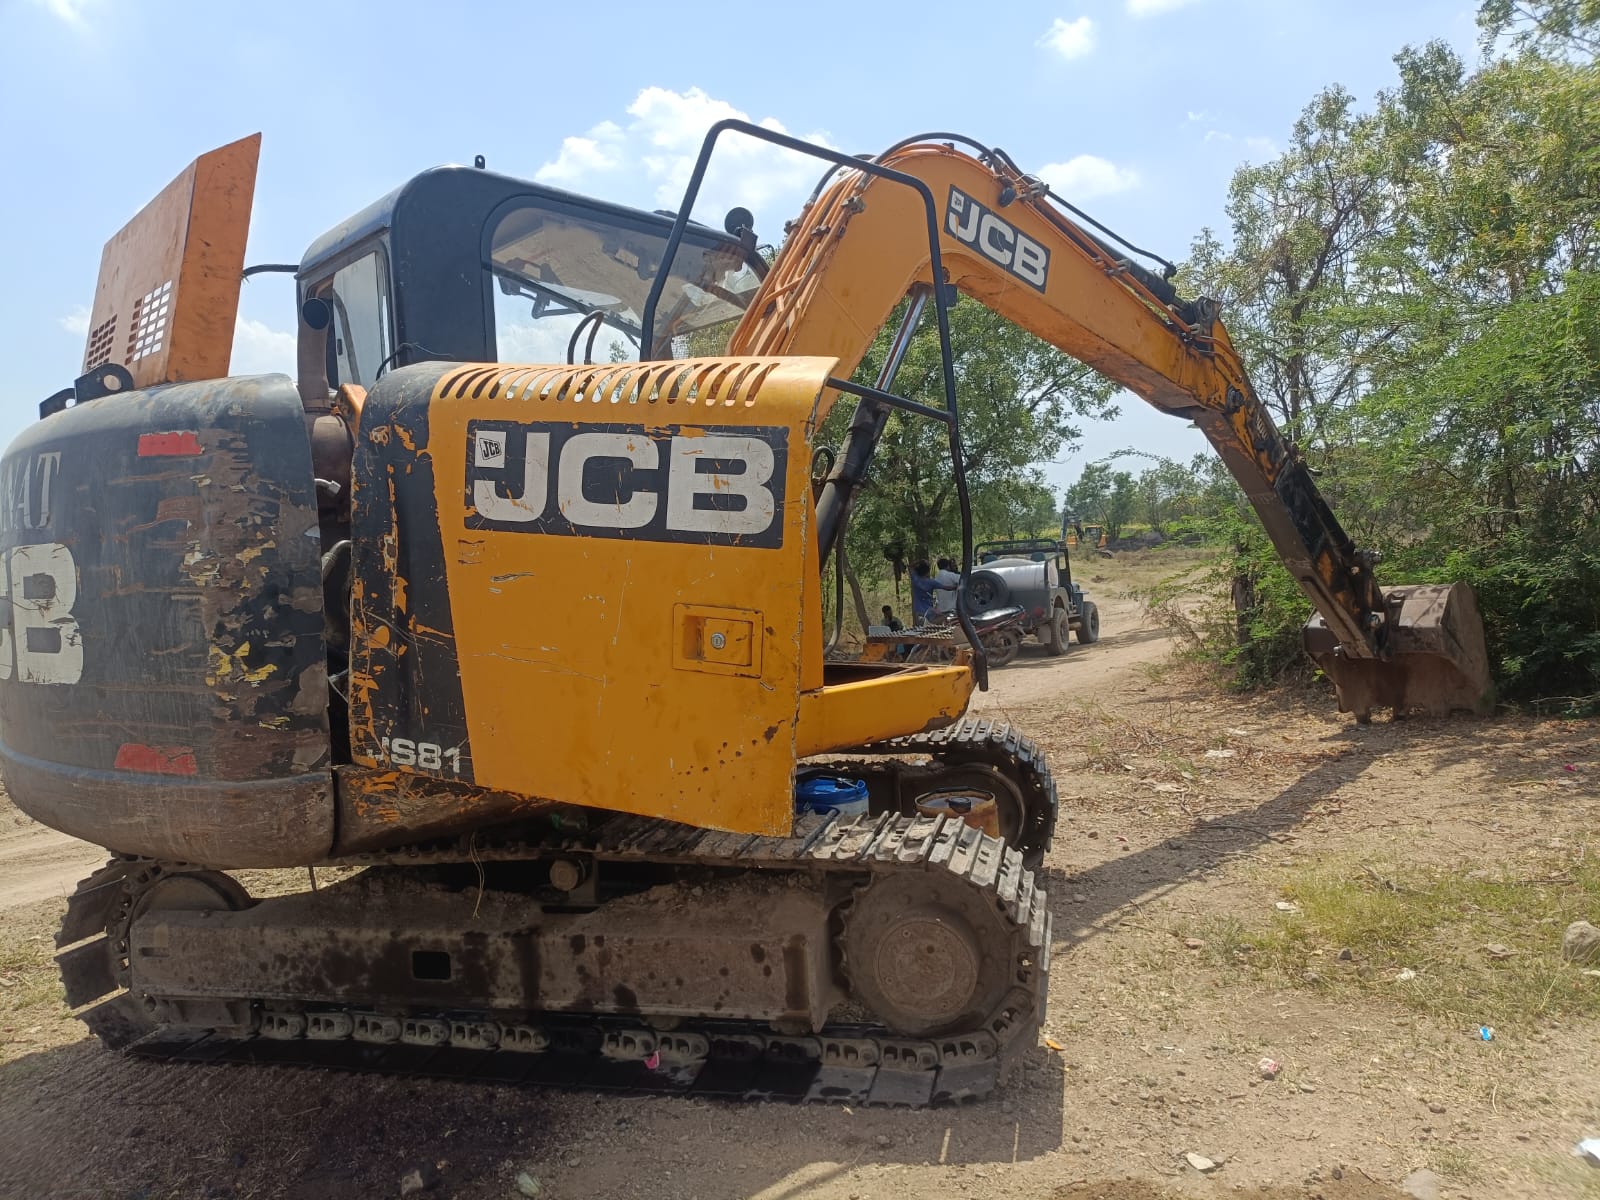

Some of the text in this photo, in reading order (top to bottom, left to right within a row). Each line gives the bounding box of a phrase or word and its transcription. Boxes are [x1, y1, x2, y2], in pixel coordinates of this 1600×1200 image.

[948, 191, 1047, 287] JCB
[474, 431, 775, 535] JCB
[482, 440, 500, 458] JCB
[0, 543, 84, 685] B
